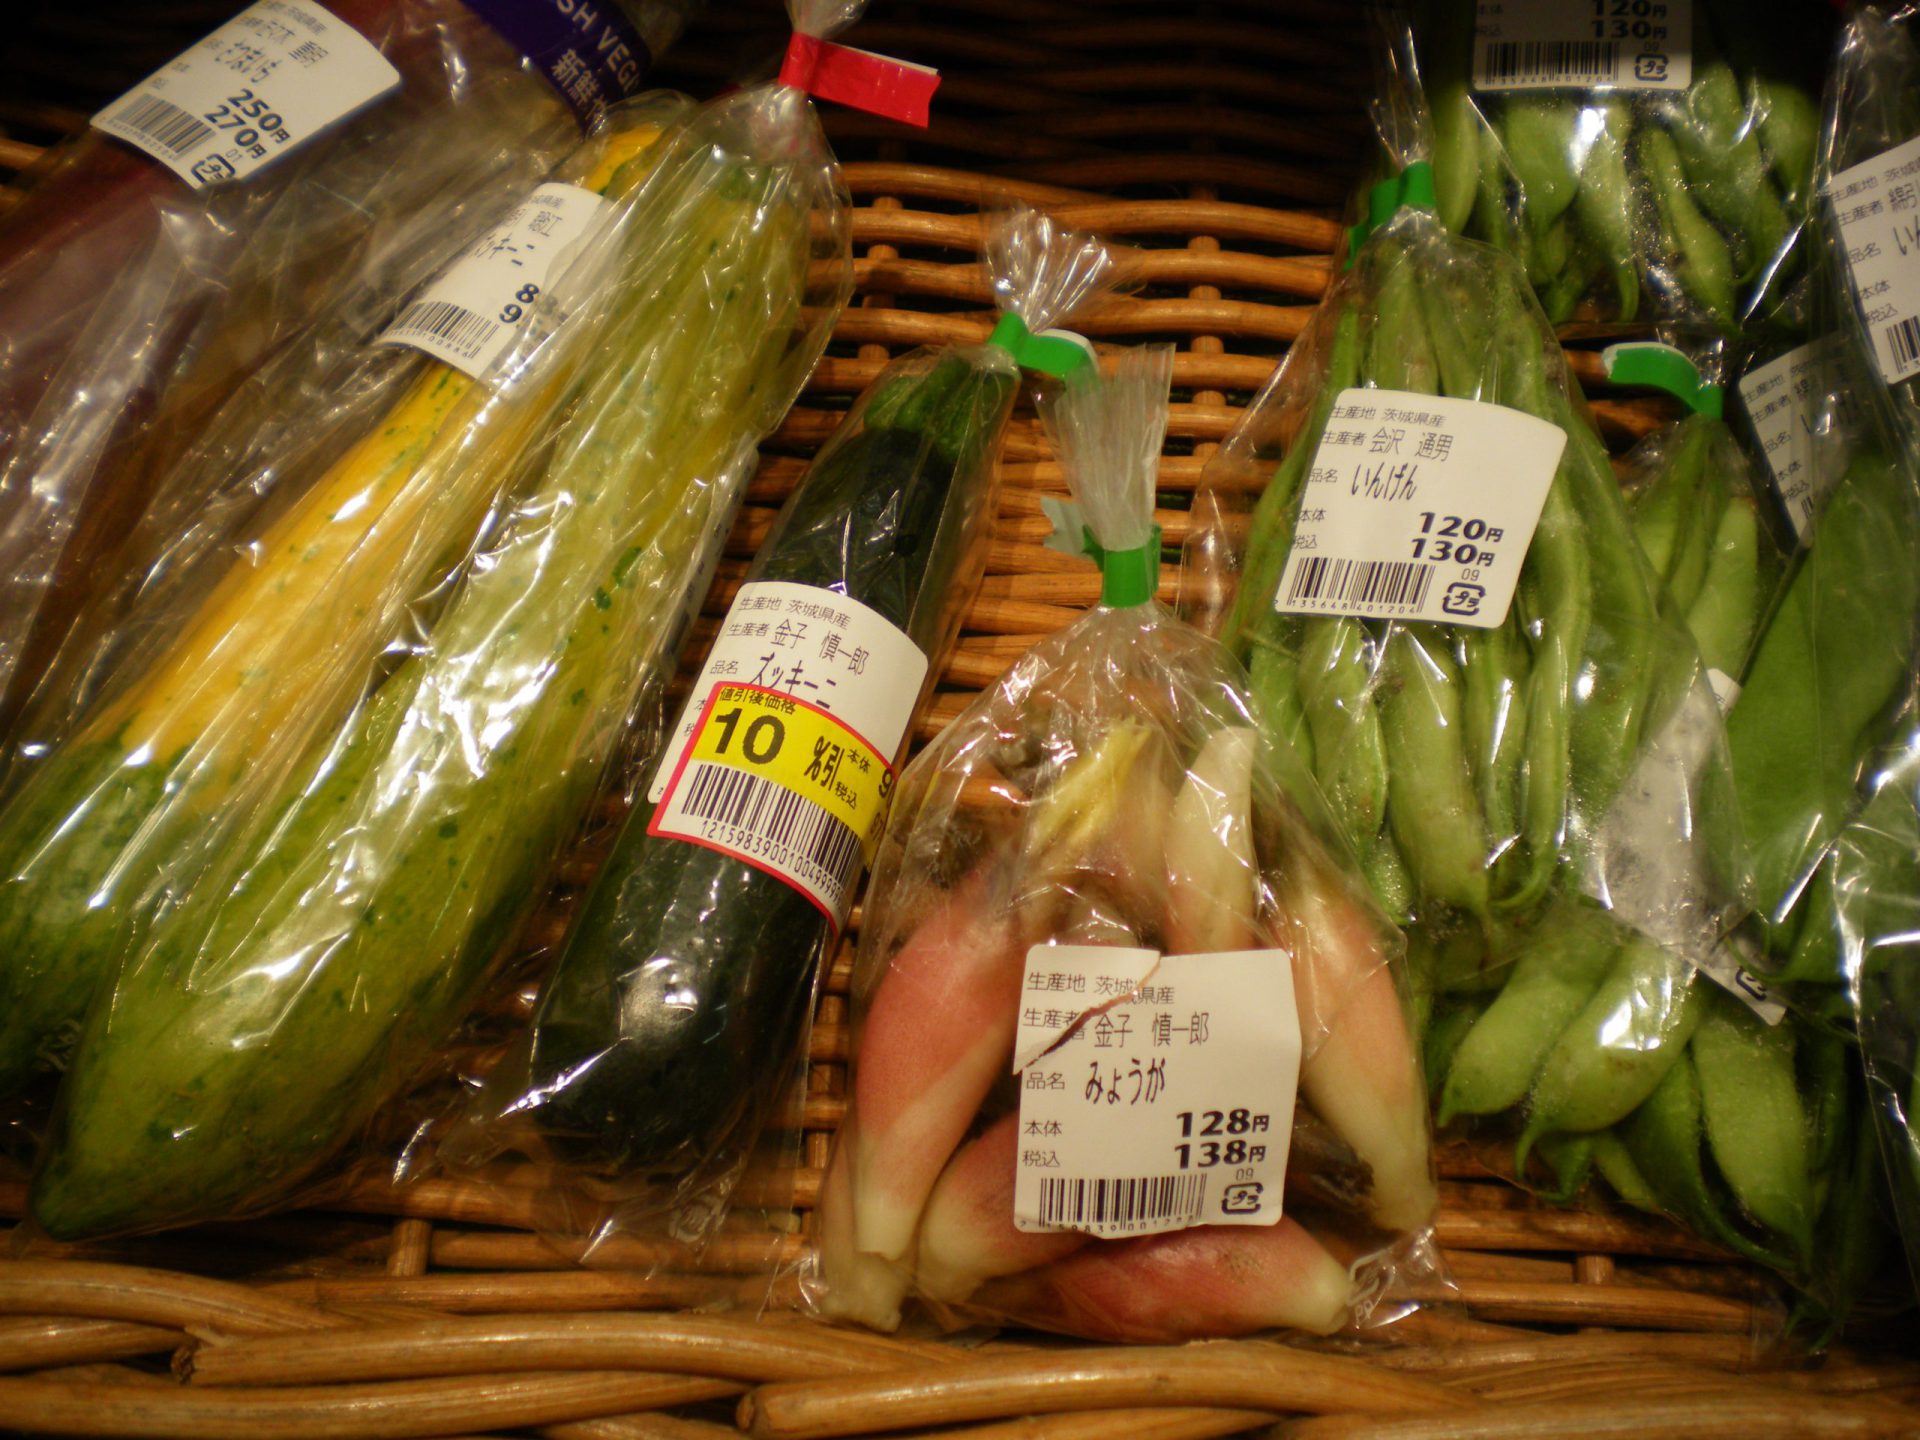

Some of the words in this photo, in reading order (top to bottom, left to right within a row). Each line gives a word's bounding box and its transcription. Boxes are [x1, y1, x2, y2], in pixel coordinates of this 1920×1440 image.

[1592, 0, 1667, 18] 120円
[1591, 19, 1666, 39] 130円
[227, 89, 291, 144] 250円
[204, 105, 267, 159] 270円
[1330, 406, 1376, 420] 生産地
[1383, 408, 1447, 428] 茨城県産
[1322, 431, 1367, 446] 生産者
[1369, 426, 1406, 455] 会沢
[1414, 431, 1454, 462] 通男
[1308, 468, 1338, 483] 品名
[1351, 461, 1418, 501] いんげん
[1299, 509, 1327, 522] 本体
[1418, 511, 1504, 543] 120円
[1293, 536, 1318, 550] 税込
[1411, 538, 1496, 567] 130円
[1461, 568, 1479, 582] 09
[737, 596, 782, 611] 生産地
[787, 600, 851, 631] 茨城県産
[727, 622, 770, 637] 生産者
[770, 618, 809, 649] 金子
[819, 629, 870, 676] 慎一郎
[710, 660, 739, 675] 品名
[749, 651, 837, 710] ズッキーニ
[720, 687, 797, 715] 値引後価格
[714, 707, 786, 765] 10
[847, 748, 871, 774] 本体
[835, 781, 857, 810] 税込
[1027, 972, 1086, 993] 生産地
[1094, 1013, 1134, 1048] 金子
[1152, 1011, 1209, 1048] 慎一郎
[1026, 1072, 1065, 1090] 品名
[1085, 1057, 1166, 1105] みょうが
[1024, 1120, 1063, 1137] 本体
[1176, 1108, 1270, 1138] 128円
[1022, 1151, 1060, 1168] 税込
[1174, 1139, 1266, 1169] 138円
[1235, 1168, 1254, 1181] 09
